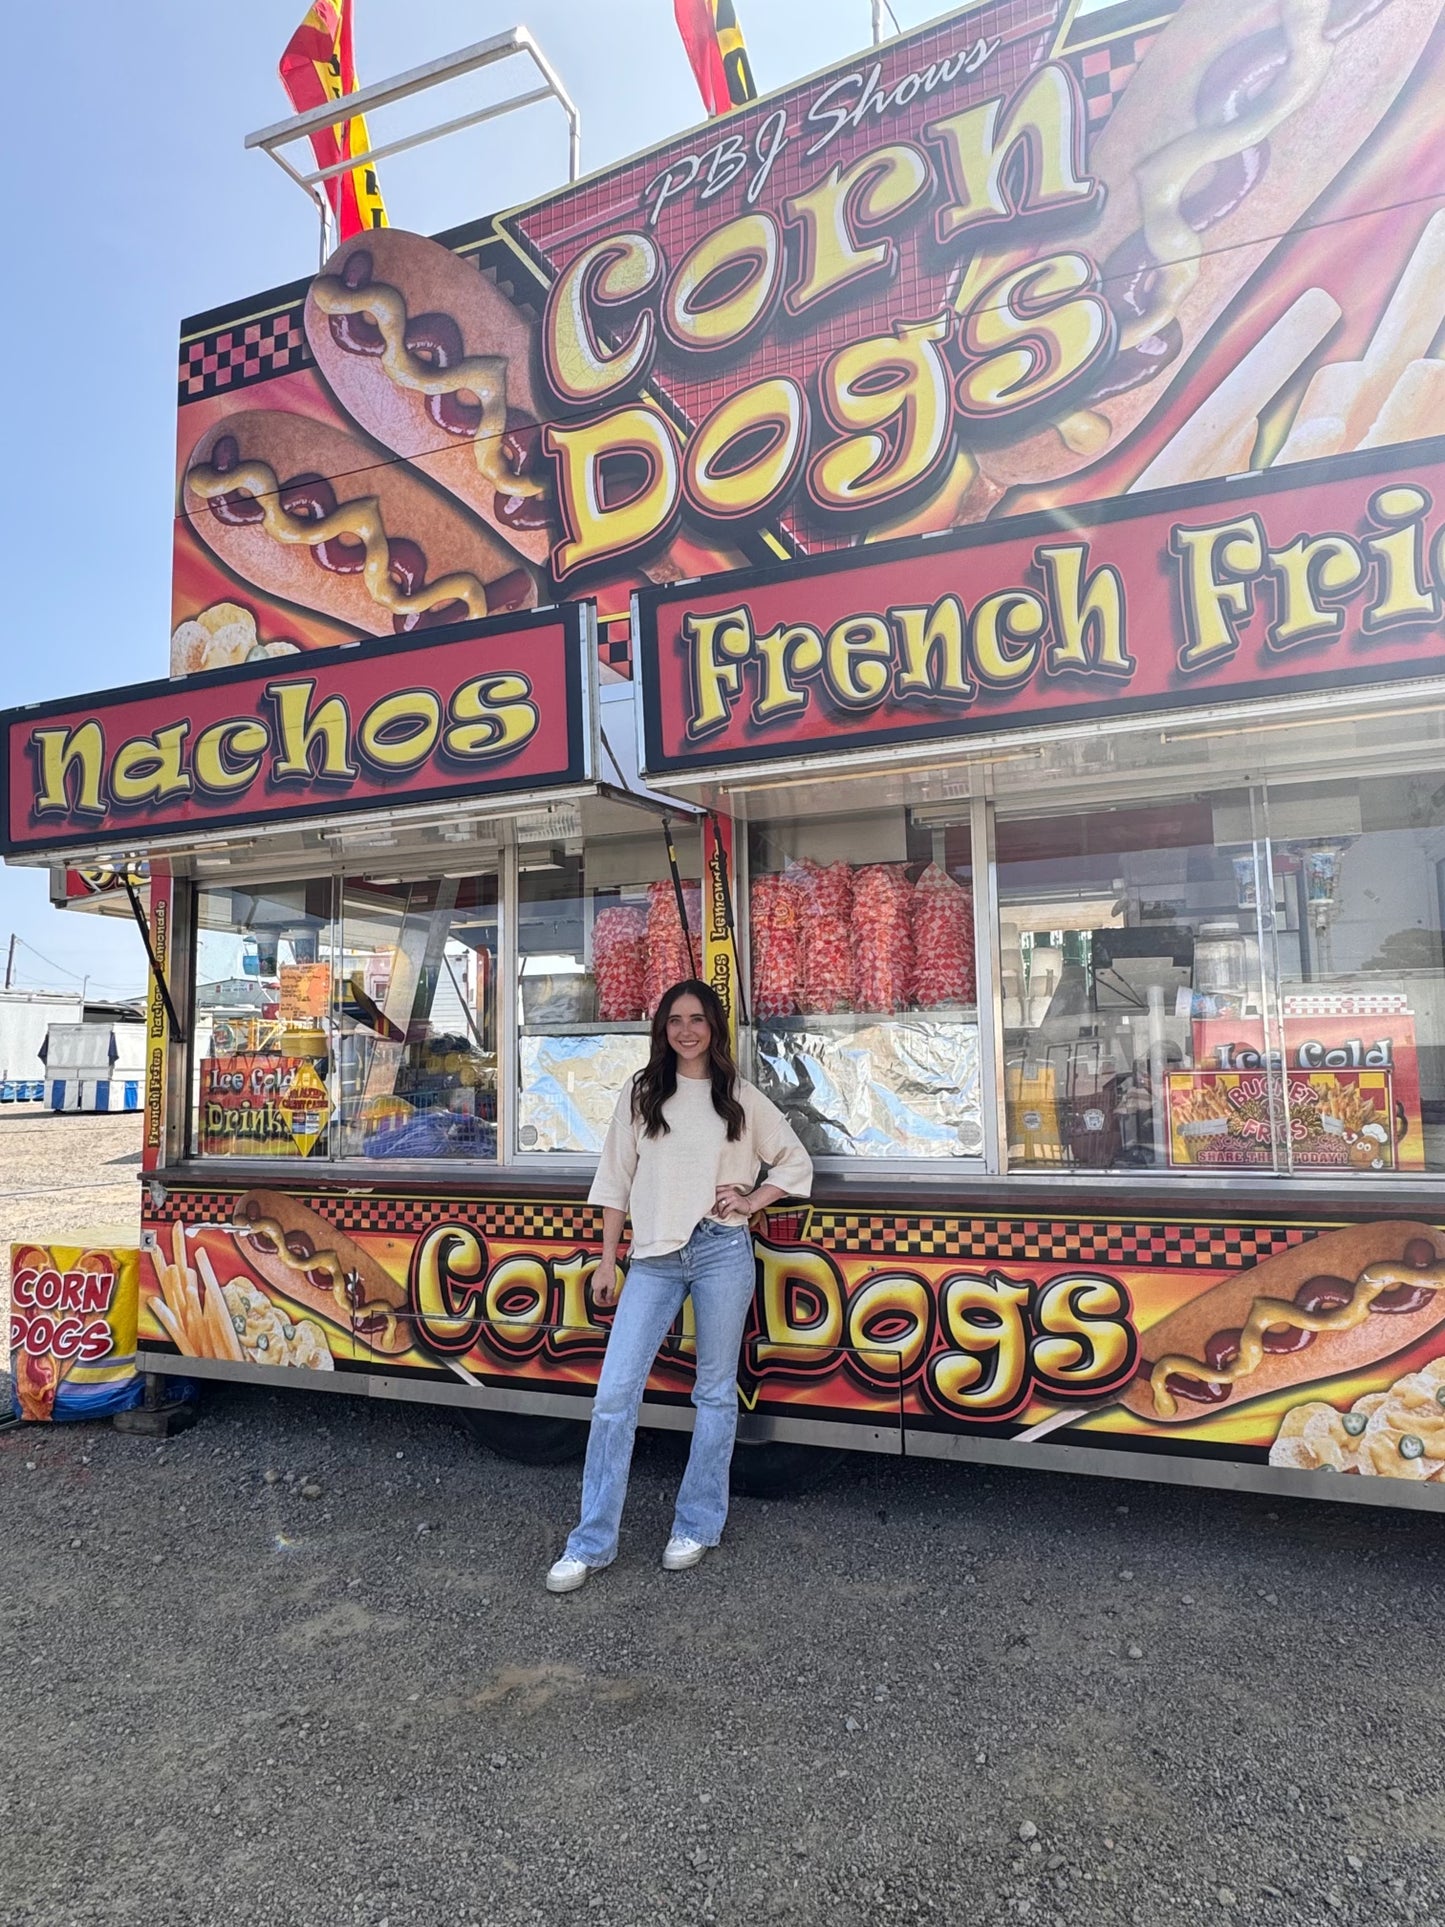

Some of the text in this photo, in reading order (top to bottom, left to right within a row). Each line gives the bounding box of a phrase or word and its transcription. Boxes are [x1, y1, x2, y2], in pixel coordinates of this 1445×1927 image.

[645, 109, 790, 226] PBJ
[806, 37, 1001, 156] Shows
[541, 59, 1102, 405] Corn
[543, 251, 1109, 581] Dogs
[683, 484, 1445, 742] French Fri
[147, 1047, 163, 1148] French Fries
[210, 1067, 296, 1090] Ice Cold
[1215, 1038, 1392, 1069] Ice Cold
[1197, 1151, 1243, 1163] SHARE
[12, 1267, 114, 1313] CORN
[748, 1238, 1139, 1421] Dogs
